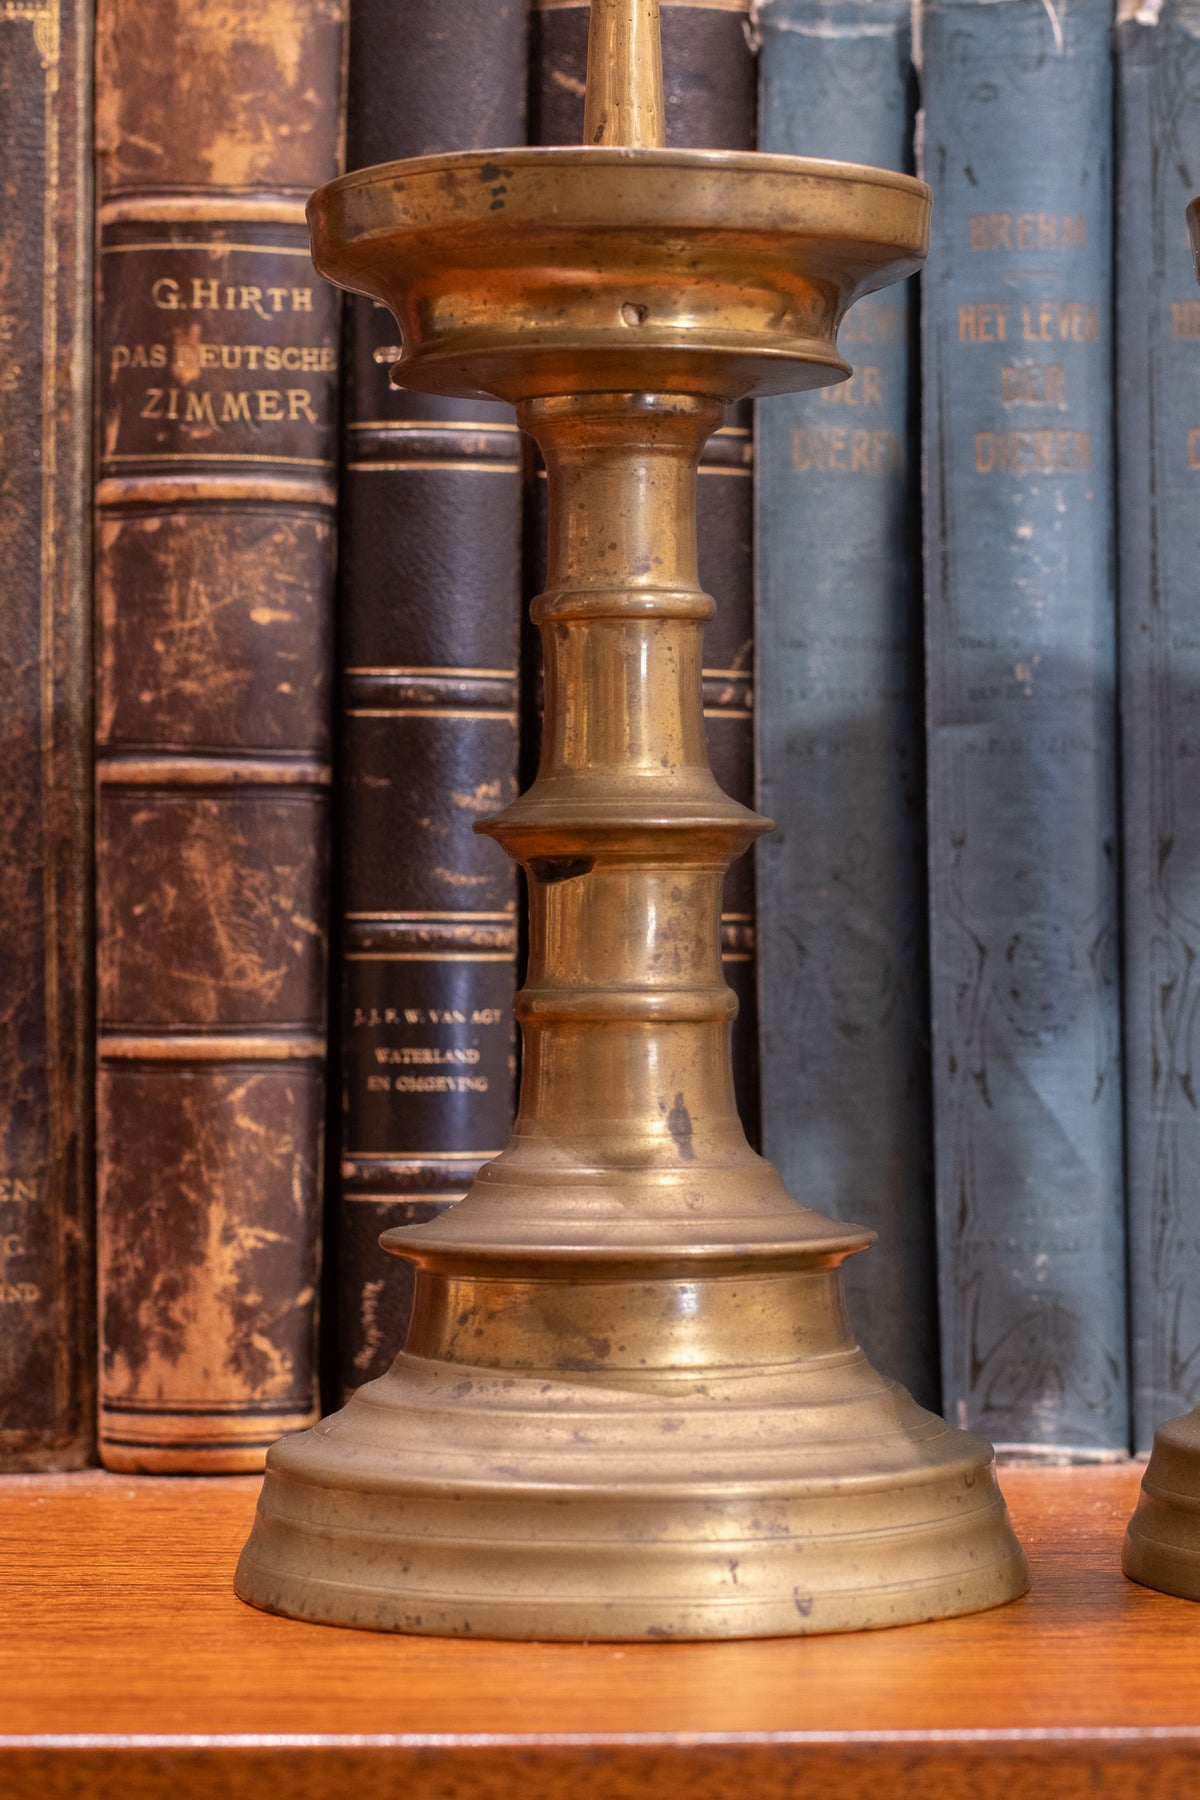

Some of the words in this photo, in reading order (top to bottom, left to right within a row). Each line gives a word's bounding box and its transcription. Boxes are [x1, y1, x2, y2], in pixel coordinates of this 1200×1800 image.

[969, 212, 1087, 252] BREHM
[958, 302, 1008, 343] HET
[1021, 302, 1101, 343] LEVEN
[112, 344, 169, 369] DAS
[176, 344, 338, 372] DEUTSCHE
[1000, 364, 1066, 404] DER
[140, 388, 321, 430] ZIMMER
[974, 429, 1093, 472] DIEREN
[428, 1008, 467, 1024] VAN
[374, 1047, 481, 1065] WATERLAND
[394, 1075, 489, 1093] OMGEVING
